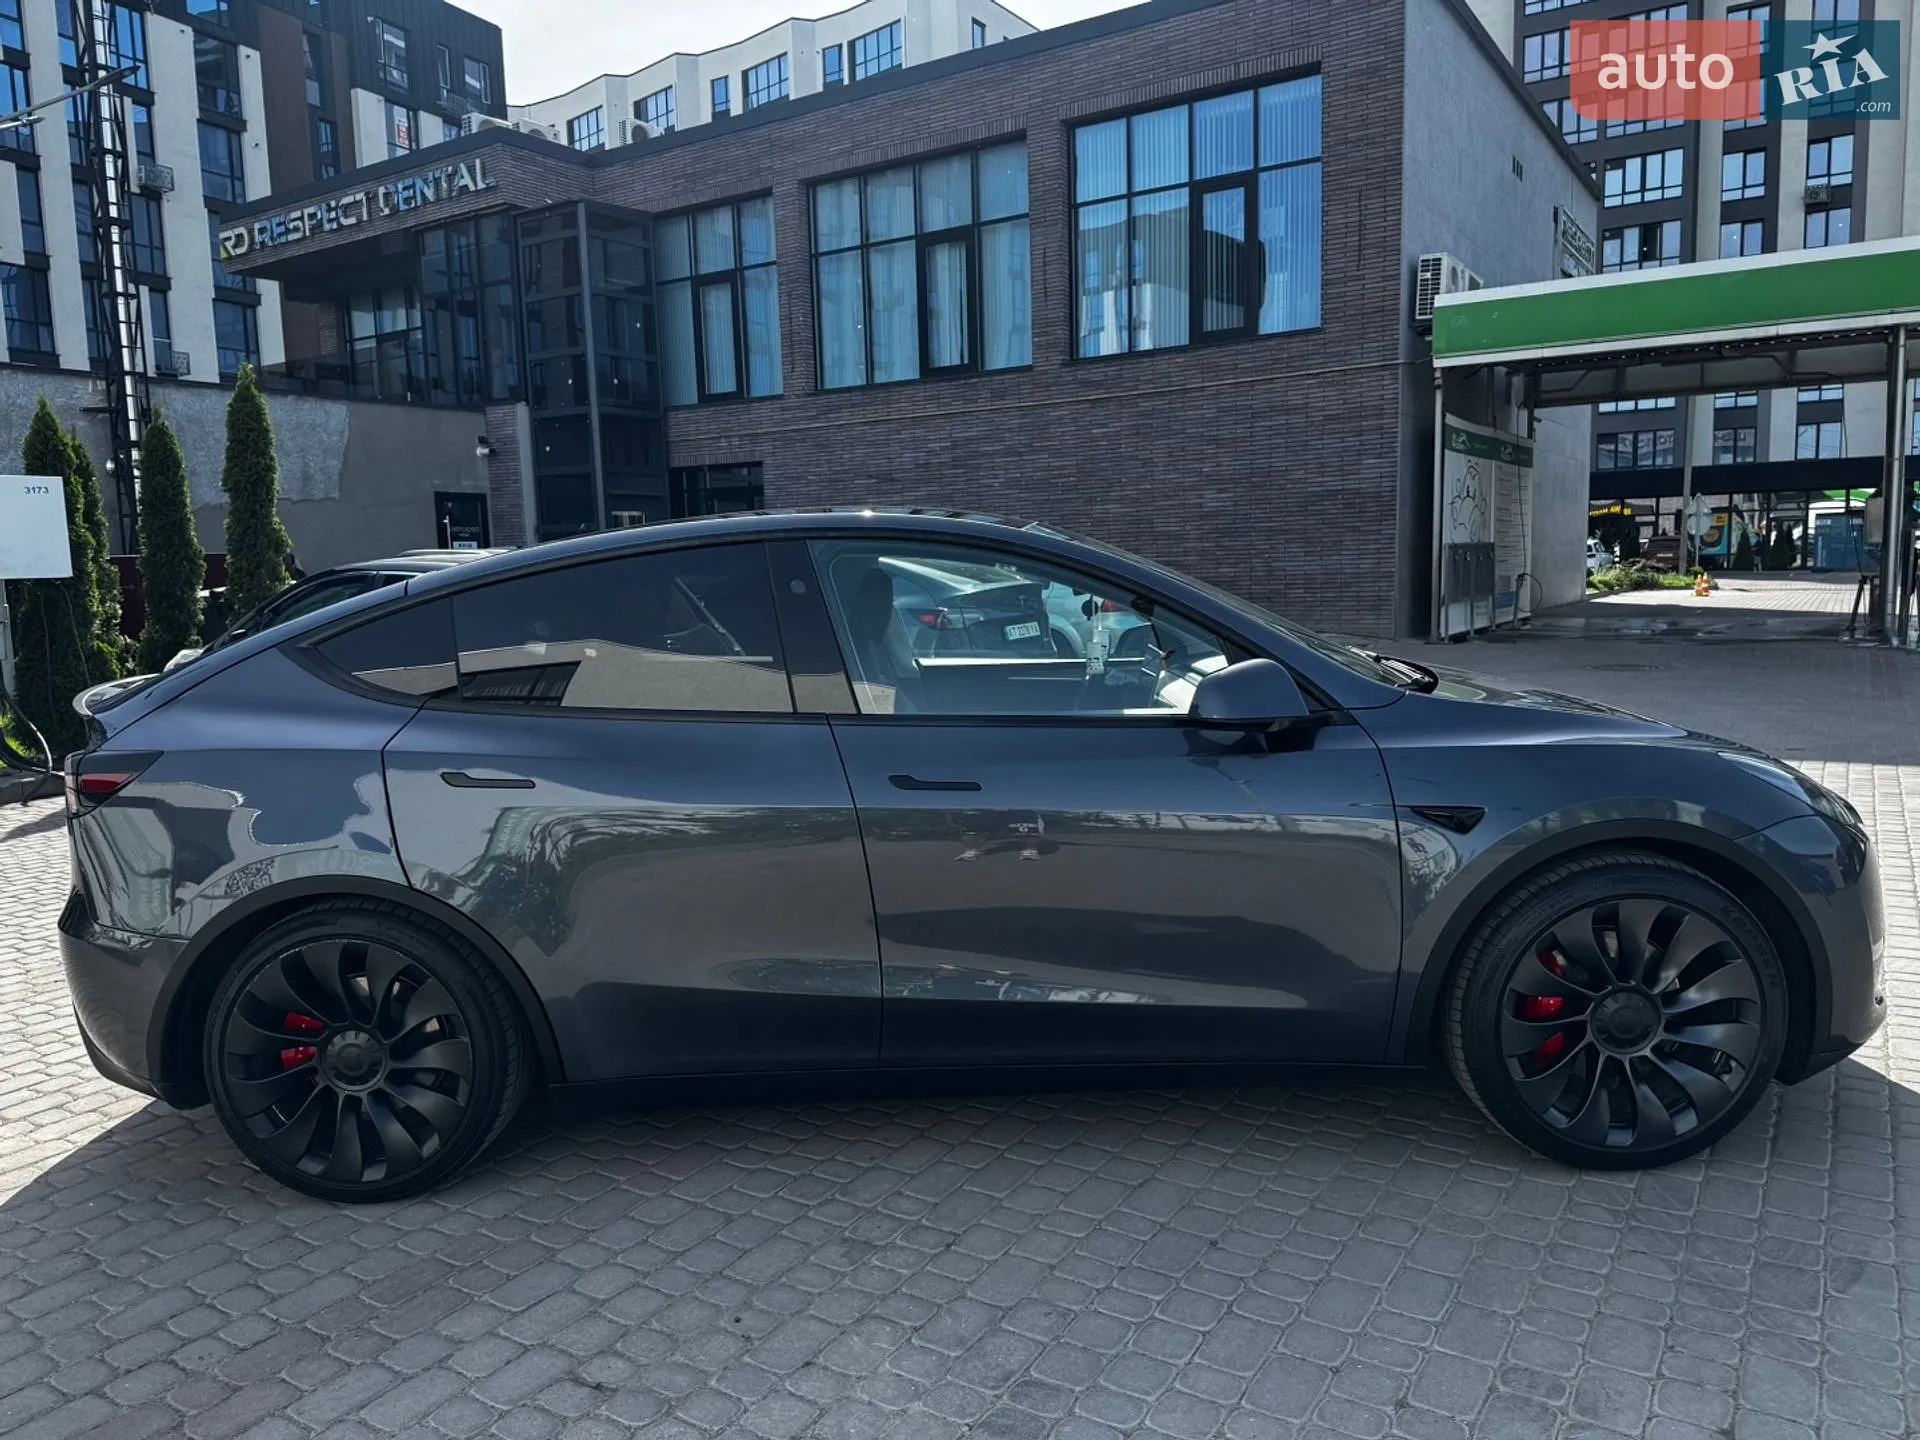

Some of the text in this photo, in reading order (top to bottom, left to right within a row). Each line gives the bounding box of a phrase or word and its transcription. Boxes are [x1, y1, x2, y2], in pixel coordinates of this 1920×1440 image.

[253, 190, 371, 249] RESPECT
[378, 158, 497, 216] DENTAL
[23, 485, 50, 495] 3173
